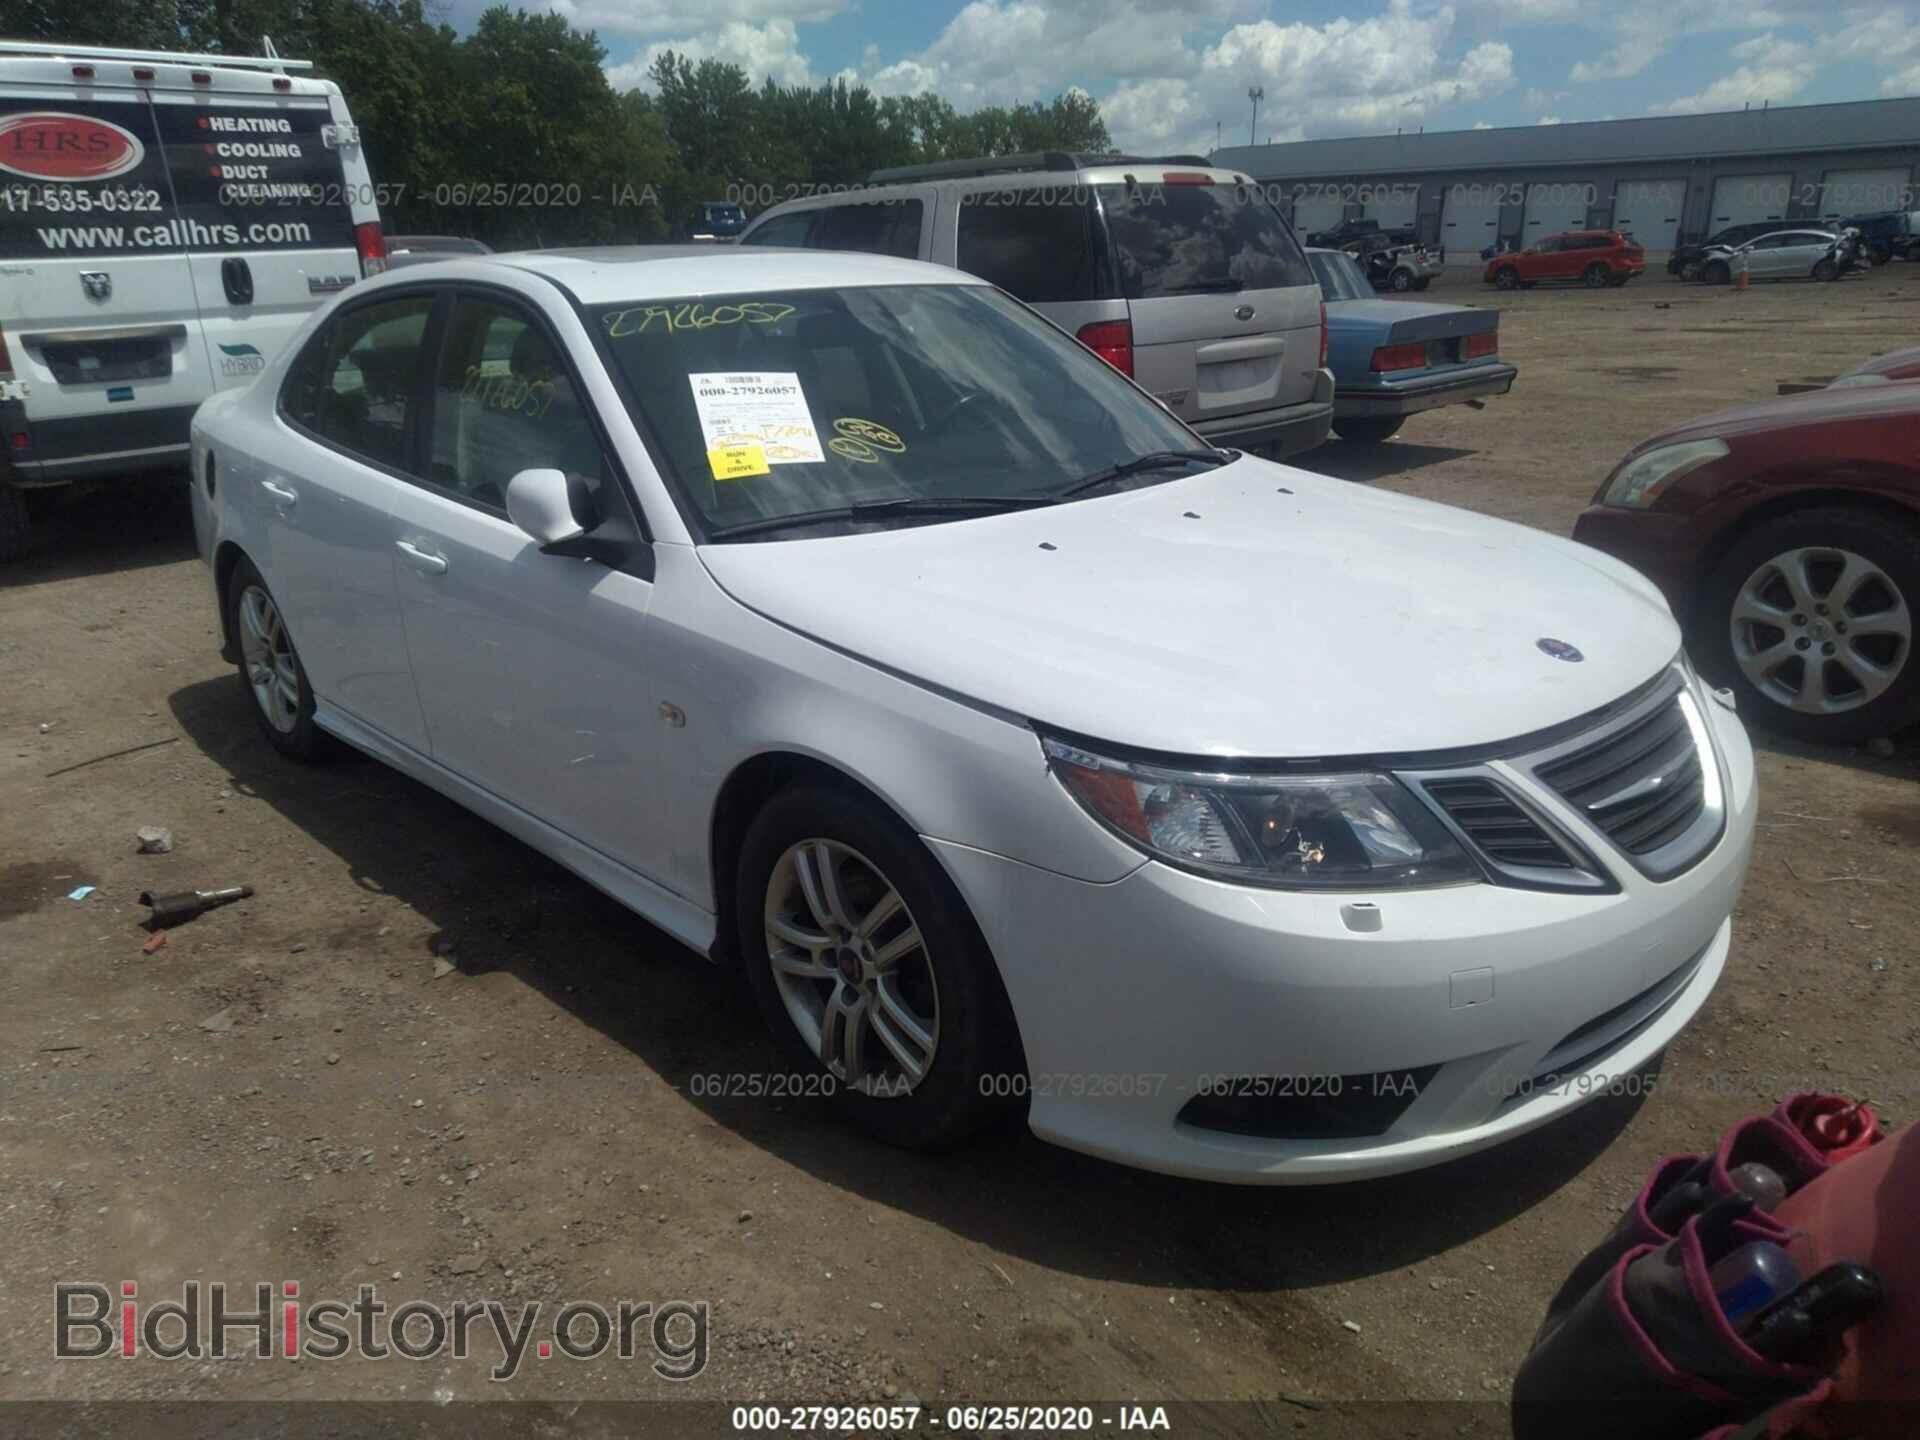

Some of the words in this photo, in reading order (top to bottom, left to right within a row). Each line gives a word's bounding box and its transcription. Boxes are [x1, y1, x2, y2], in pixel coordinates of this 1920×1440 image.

[209, 117, 292, 132] HEATING
[12, 129, 112, 152] HRS
[217, 143, 302, 158] COOLING
[221, 165, 268, 179] DUCT
[226, 184, 312, 198] CLEANING
[38, 219, 311, 248] www.callhrs.com
[602, 303, 796, 337] 27926057
[699, 386, 797, 397] 000-27926057
